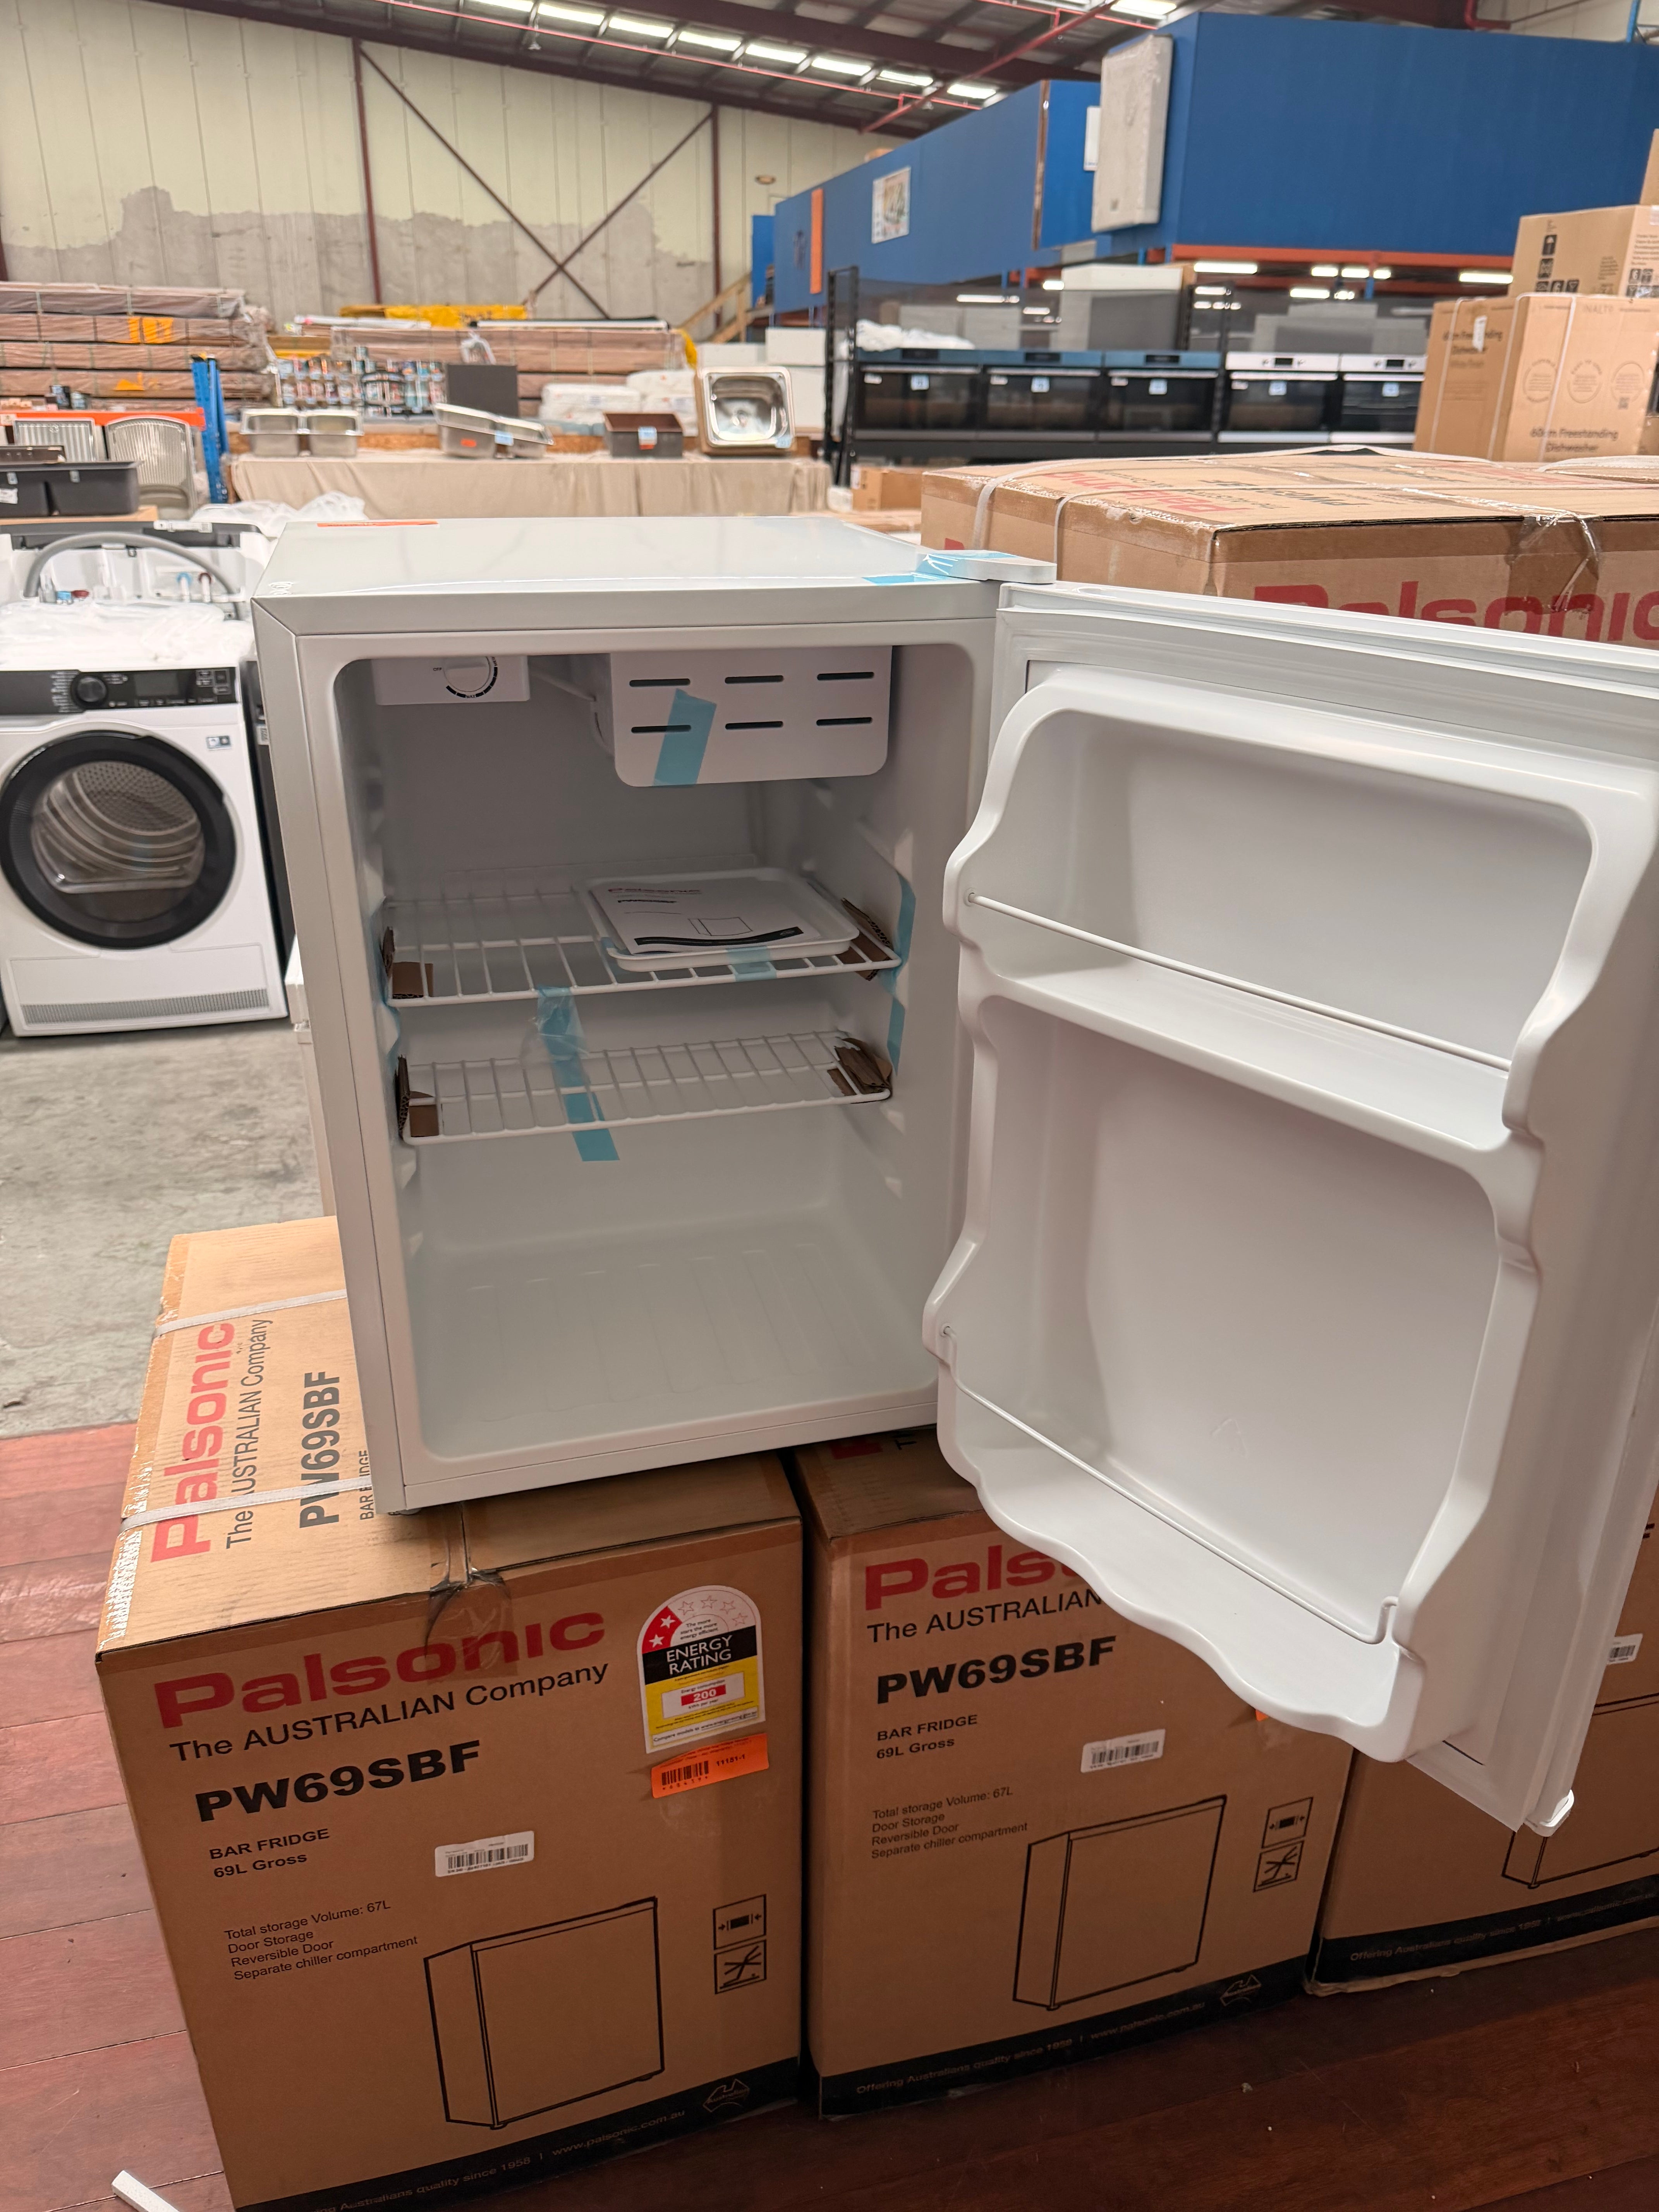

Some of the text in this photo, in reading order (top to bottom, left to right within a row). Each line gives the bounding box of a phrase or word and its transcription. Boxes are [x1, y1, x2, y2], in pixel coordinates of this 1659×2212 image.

[150, 1323, 235, 1563] Palsonic
[226, 1319, 273, 1549] The USTRALIAN Company
[360, 1494, 374, 1520] BAR
[866, 1544, 1080, 1611] Pals
[867, 1589, 1103, 1643] The AUSTRALIAN
[666, 1635, 733, 1662] ENERGY
[669, 1649, 732, 1675] RATING
[154, 1611, 605, 1729] Palsonic
[877, 1635, 1116, 1704] PW69SBF
[693, 1689, 716, 1702] 200
[170, 1663, 608, 1761] The AUSTRALIAN Company
[877, 1714, 978, 1741] BAR FRIDGE
[876, 1739, 955, 1759] 69L Gross
[196, 1740, 479, 1822] PW69SBF
[872, 1787, 1013, 1819] Total storage Volume: 67L
[872, 1814, 945, 1832] Door Storage
[872, 1824, 960, 1846] Reversible Door
[209, 1828, 330, 1859] BAR FRIDGE
[871, 1822, 1028, 1859] Separate chiller compartment
[213, 1853, 307, 1878] 69L Gross
[224, 1900, 391, 1940] Total storage Volume: 67L
[228, 1931, 313, 1954] Door Storage
[231, 1941, 334, 1967] Reversible Door
[234, 1936, 418, 1980] Separate chiller compartment
[340, 2110, 685, 2211] Australians quality since 1958 www.palsonic.com.au
